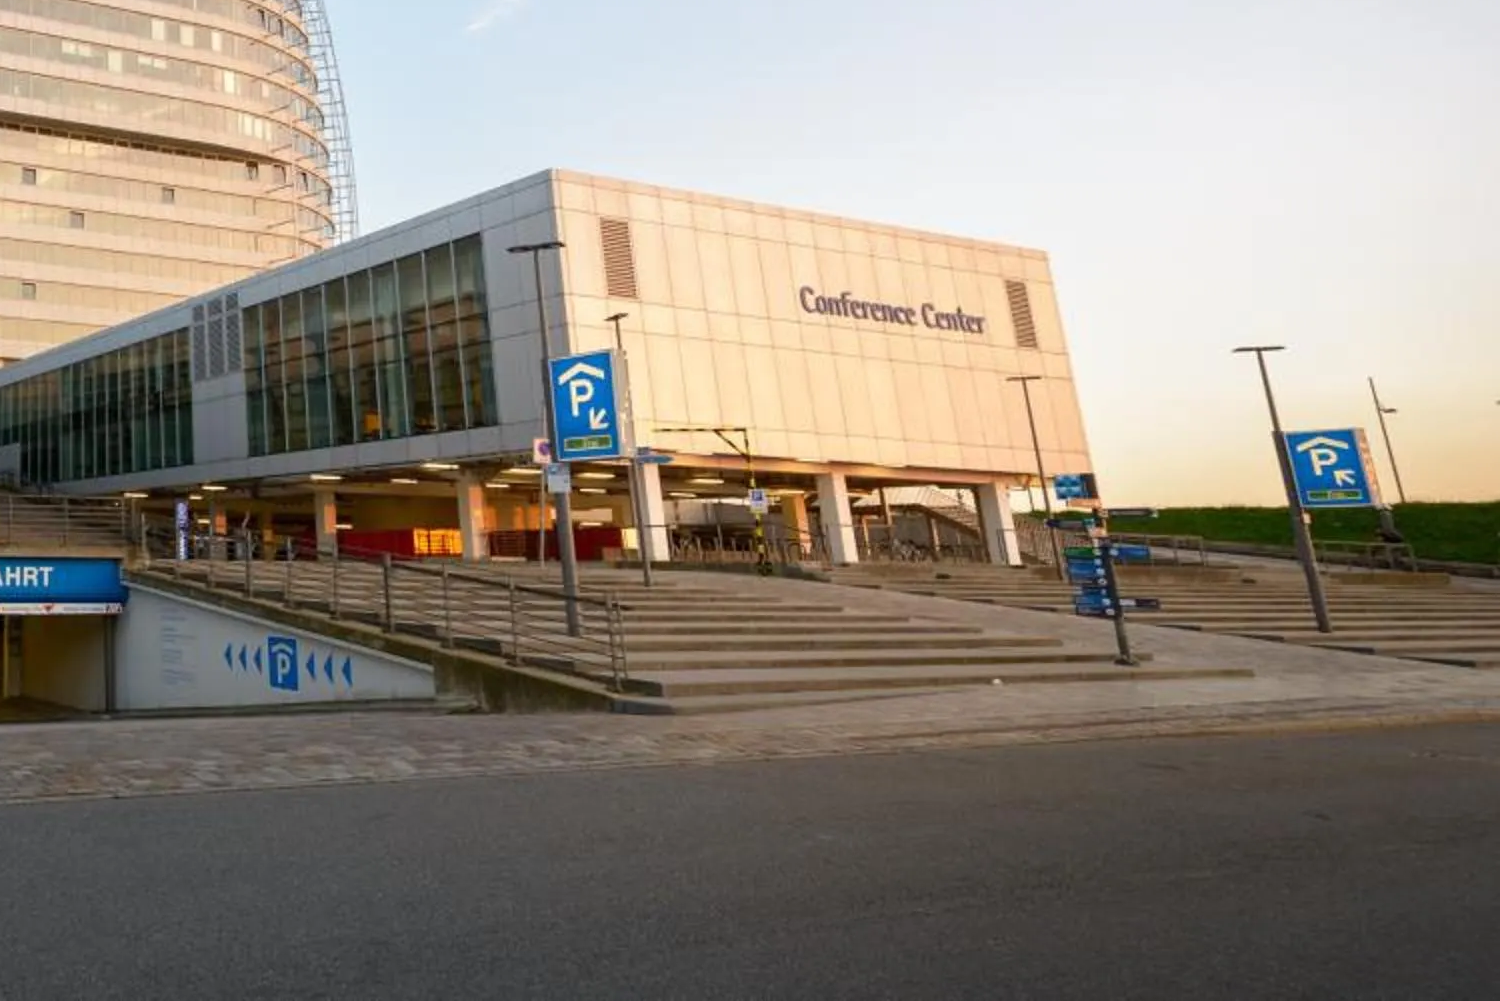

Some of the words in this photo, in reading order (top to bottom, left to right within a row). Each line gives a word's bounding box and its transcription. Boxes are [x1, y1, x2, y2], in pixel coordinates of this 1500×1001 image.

[799, 286, 918, 327] Conference
[921, 302, 986, 334] Center
[569, 378, 594, 417] P
[1310, 448, 1338, 476] P
[277, 652, 290, 684] P
